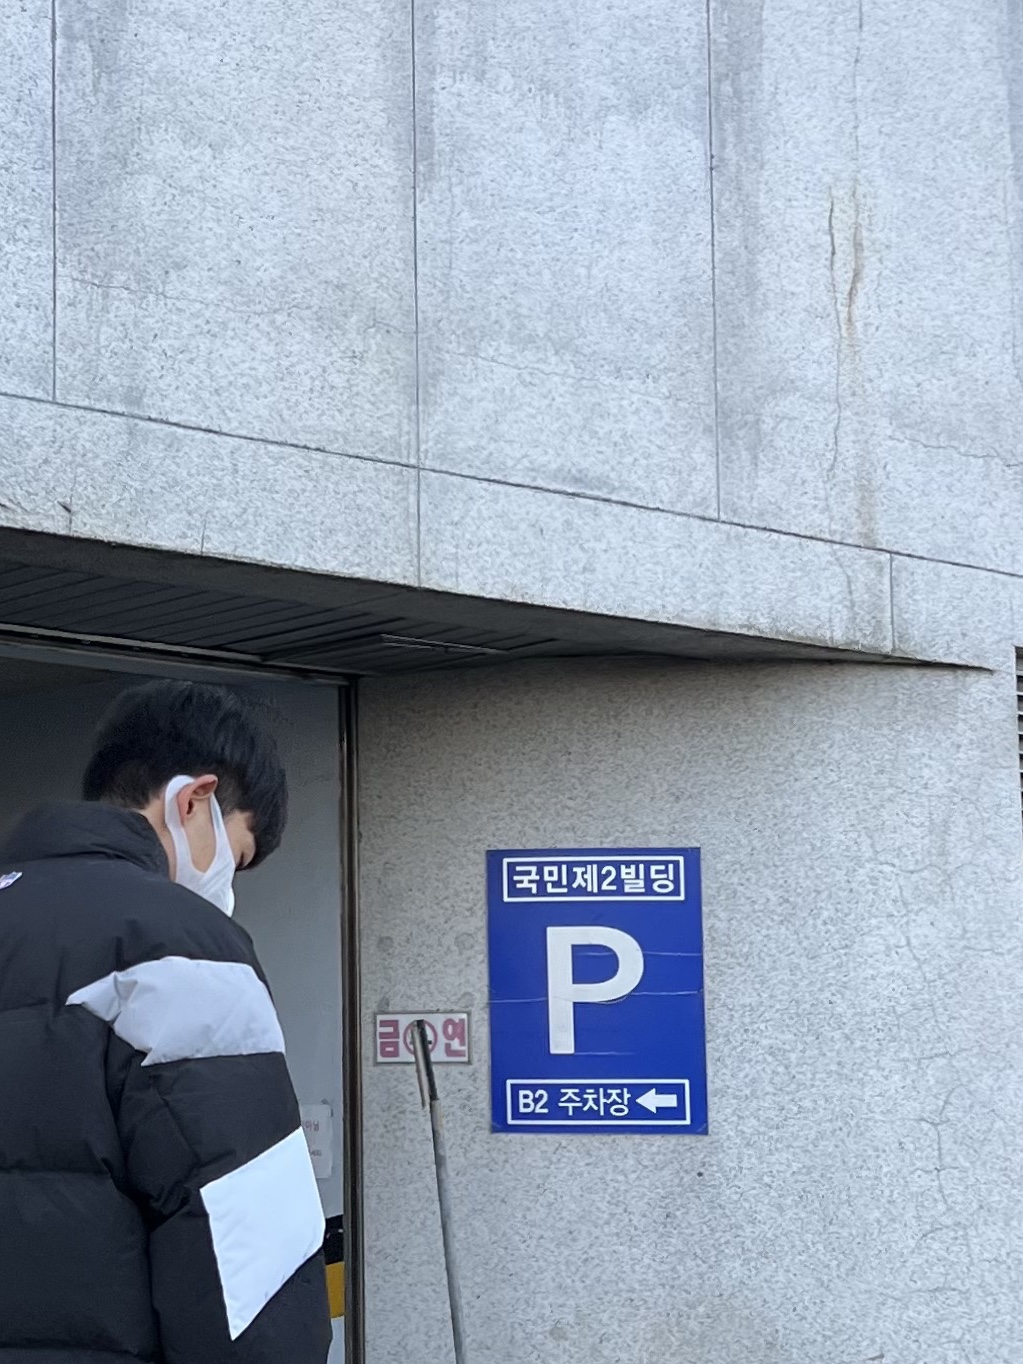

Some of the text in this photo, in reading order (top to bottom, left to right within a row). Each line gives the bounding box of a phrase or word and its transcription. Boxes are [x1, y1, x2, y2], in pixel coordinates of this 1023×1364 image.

[513, 864, 675, 894] 국민제2빌딩
[547, 926, 644, 1054] P
[378, 1018, 466, 1058] 금 연
[518, 1088, 631, 1117] B2 주차장
